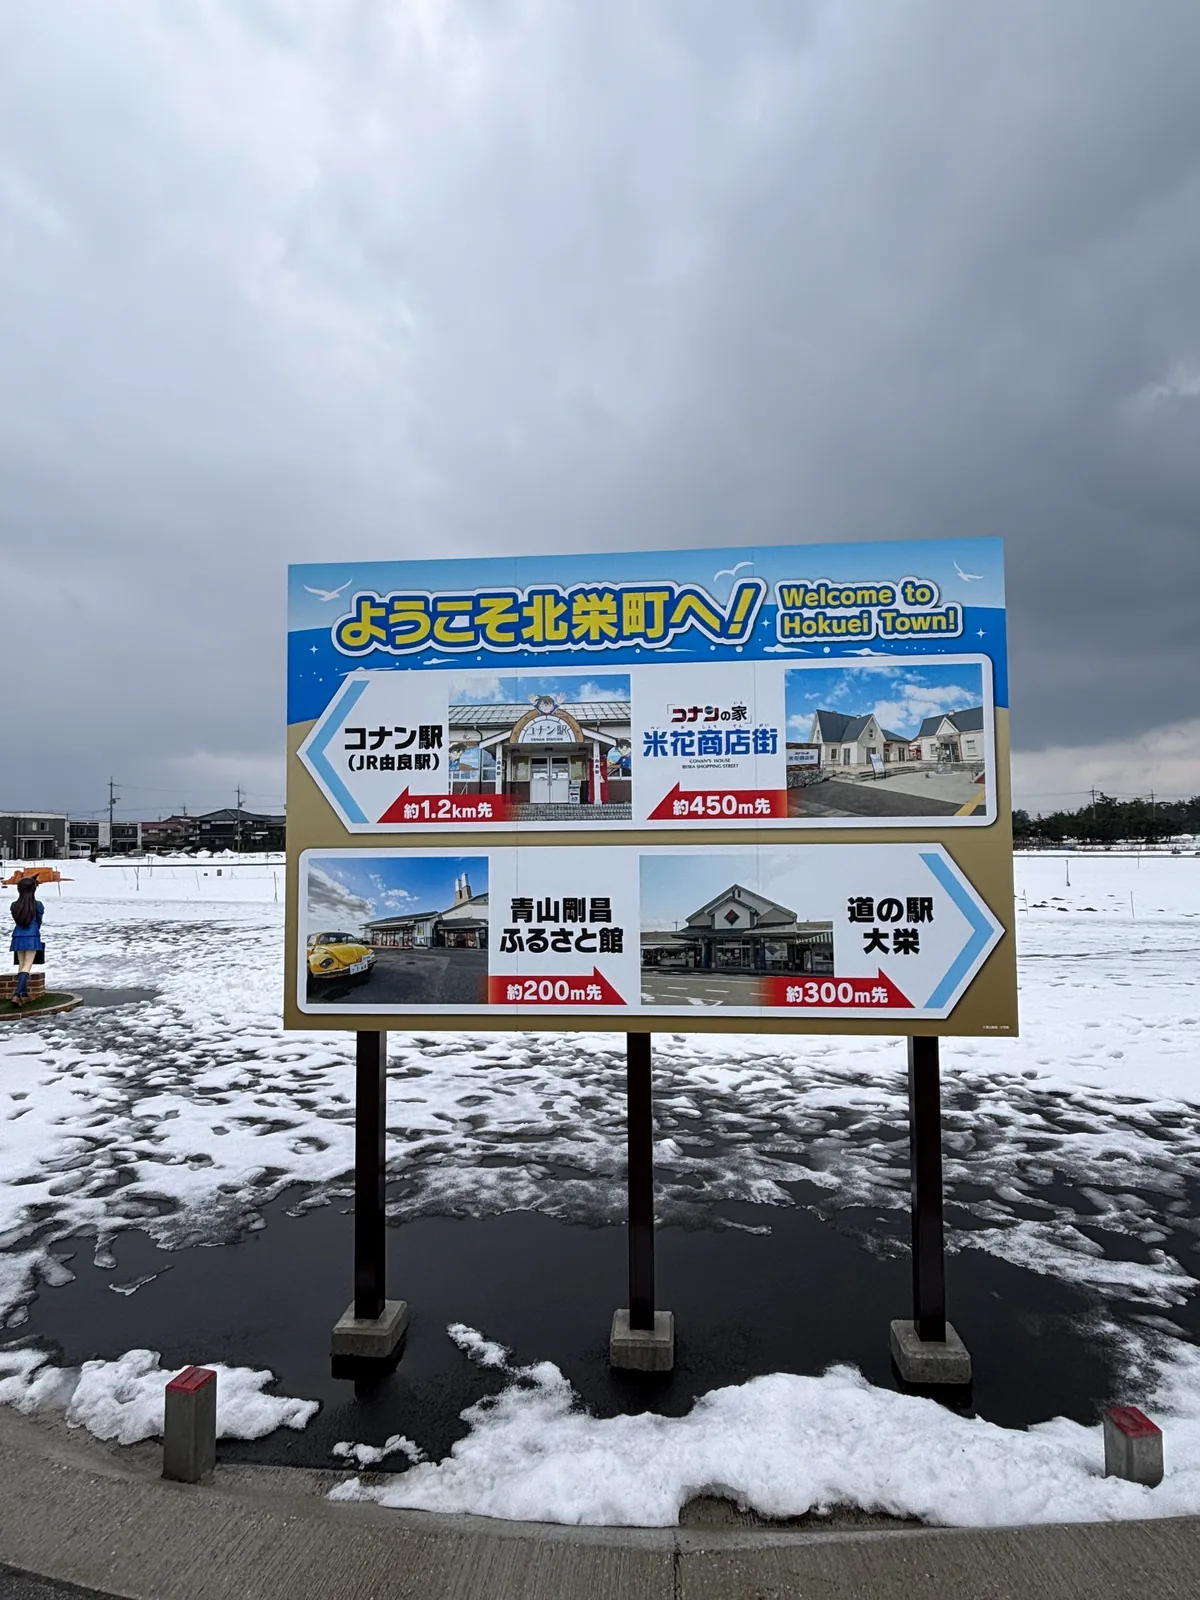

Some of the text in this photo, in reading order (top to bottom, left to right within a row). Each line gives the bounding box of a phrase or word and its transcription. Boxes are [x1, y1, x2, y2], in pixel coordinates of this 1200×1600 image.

[782, 584, 931, 607] Welcome to
[340, 587, 756, 647] ようこそ北栄町へ!
[783, 610, 956, 635] Hokuei Town!
[344, 724, 443, 751] コナン駅
[526, 724, 568, 736] コナン駅
[643, 728, 778, 757] 米花商店街
[348, 752, 440, 772] (JR由良駅)
[403, 799, 493, 820] 約1.2km先
[672, 794, 771, 816] 約450m先
[510, 896, 612, 924] 青山剛昌
[847, 896, 934, 923] 道の駅
[499, 927, 624, 954] ふるさと館
[863, 927, 921, 955] 大栄
[506, 980, 603, 1001] 約200m先
[786, 981, 888, 1004] 約300m先
